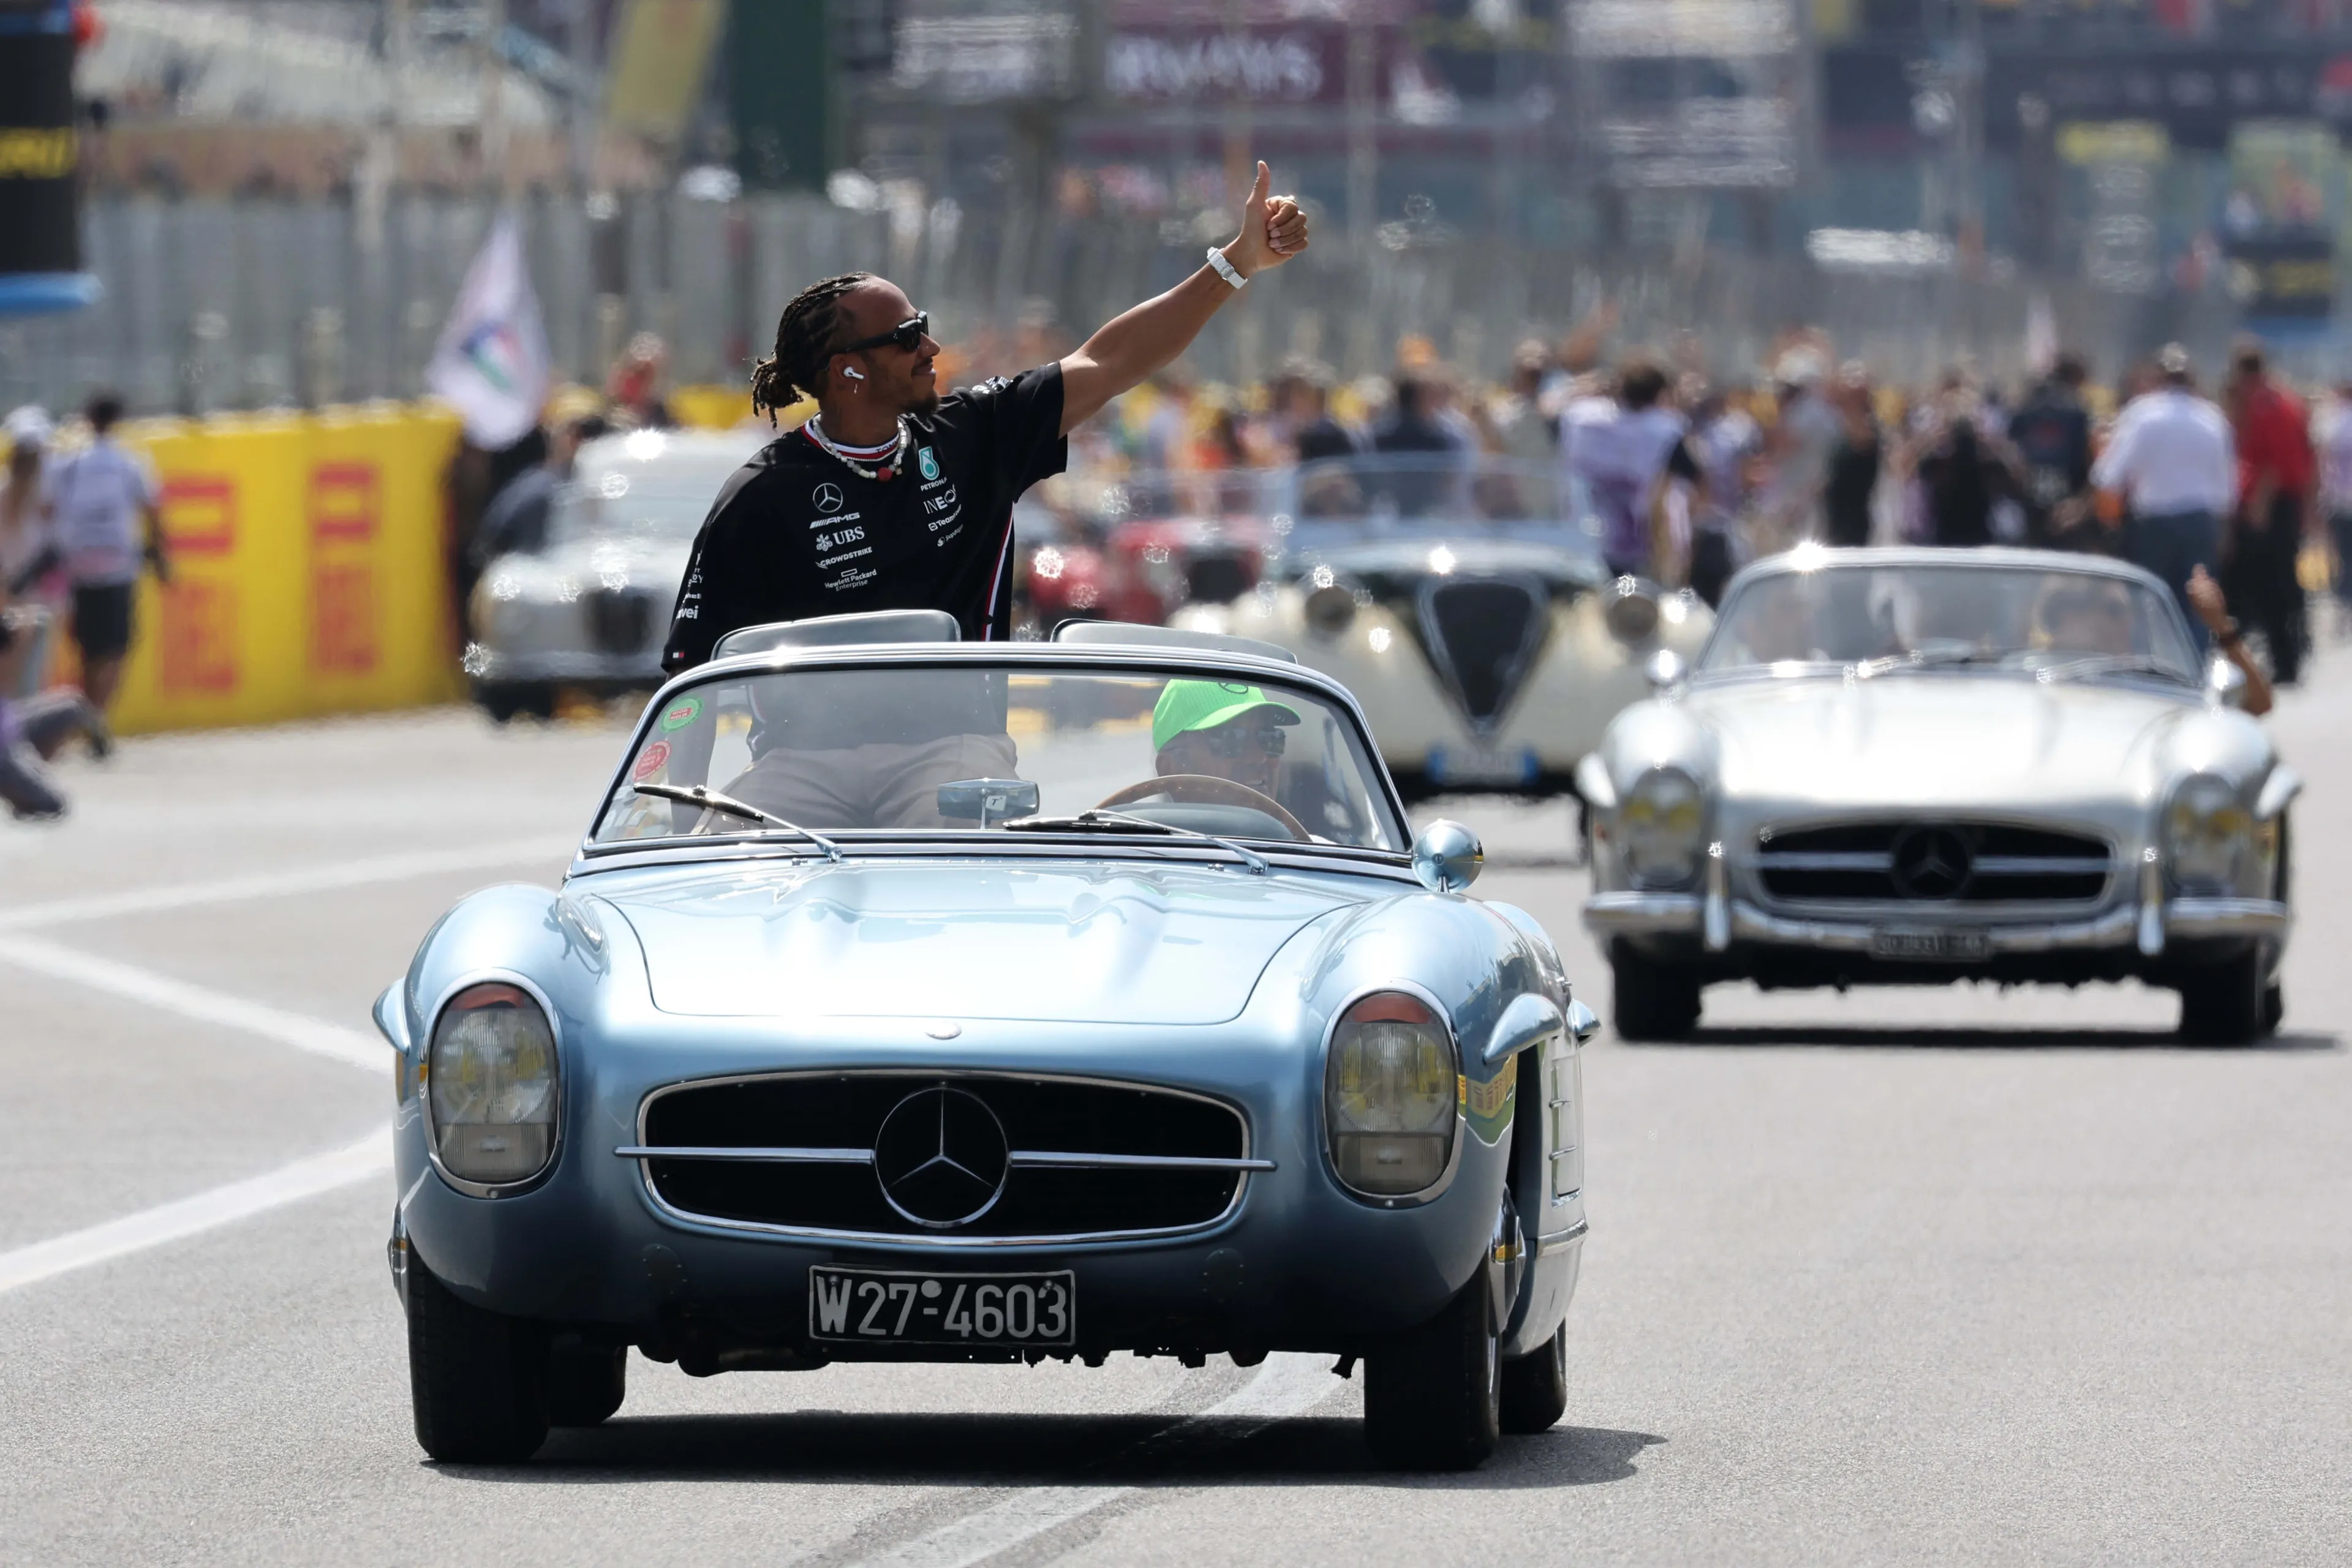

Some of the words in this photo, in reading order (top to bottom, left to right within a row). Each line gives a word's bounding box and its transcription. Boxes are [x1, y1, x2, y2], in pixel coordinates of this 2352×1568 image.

[832, 526, 865, 545] UBS
[820, 546, 873, 567] CROWDSTRIKE
[824, 577, 850, 588] Hewlett
[850, 569, 877, 581] Packard
[835, 579, 868, 592] Enterprise
[816, 1276, 1066, 1338] W27-4603
